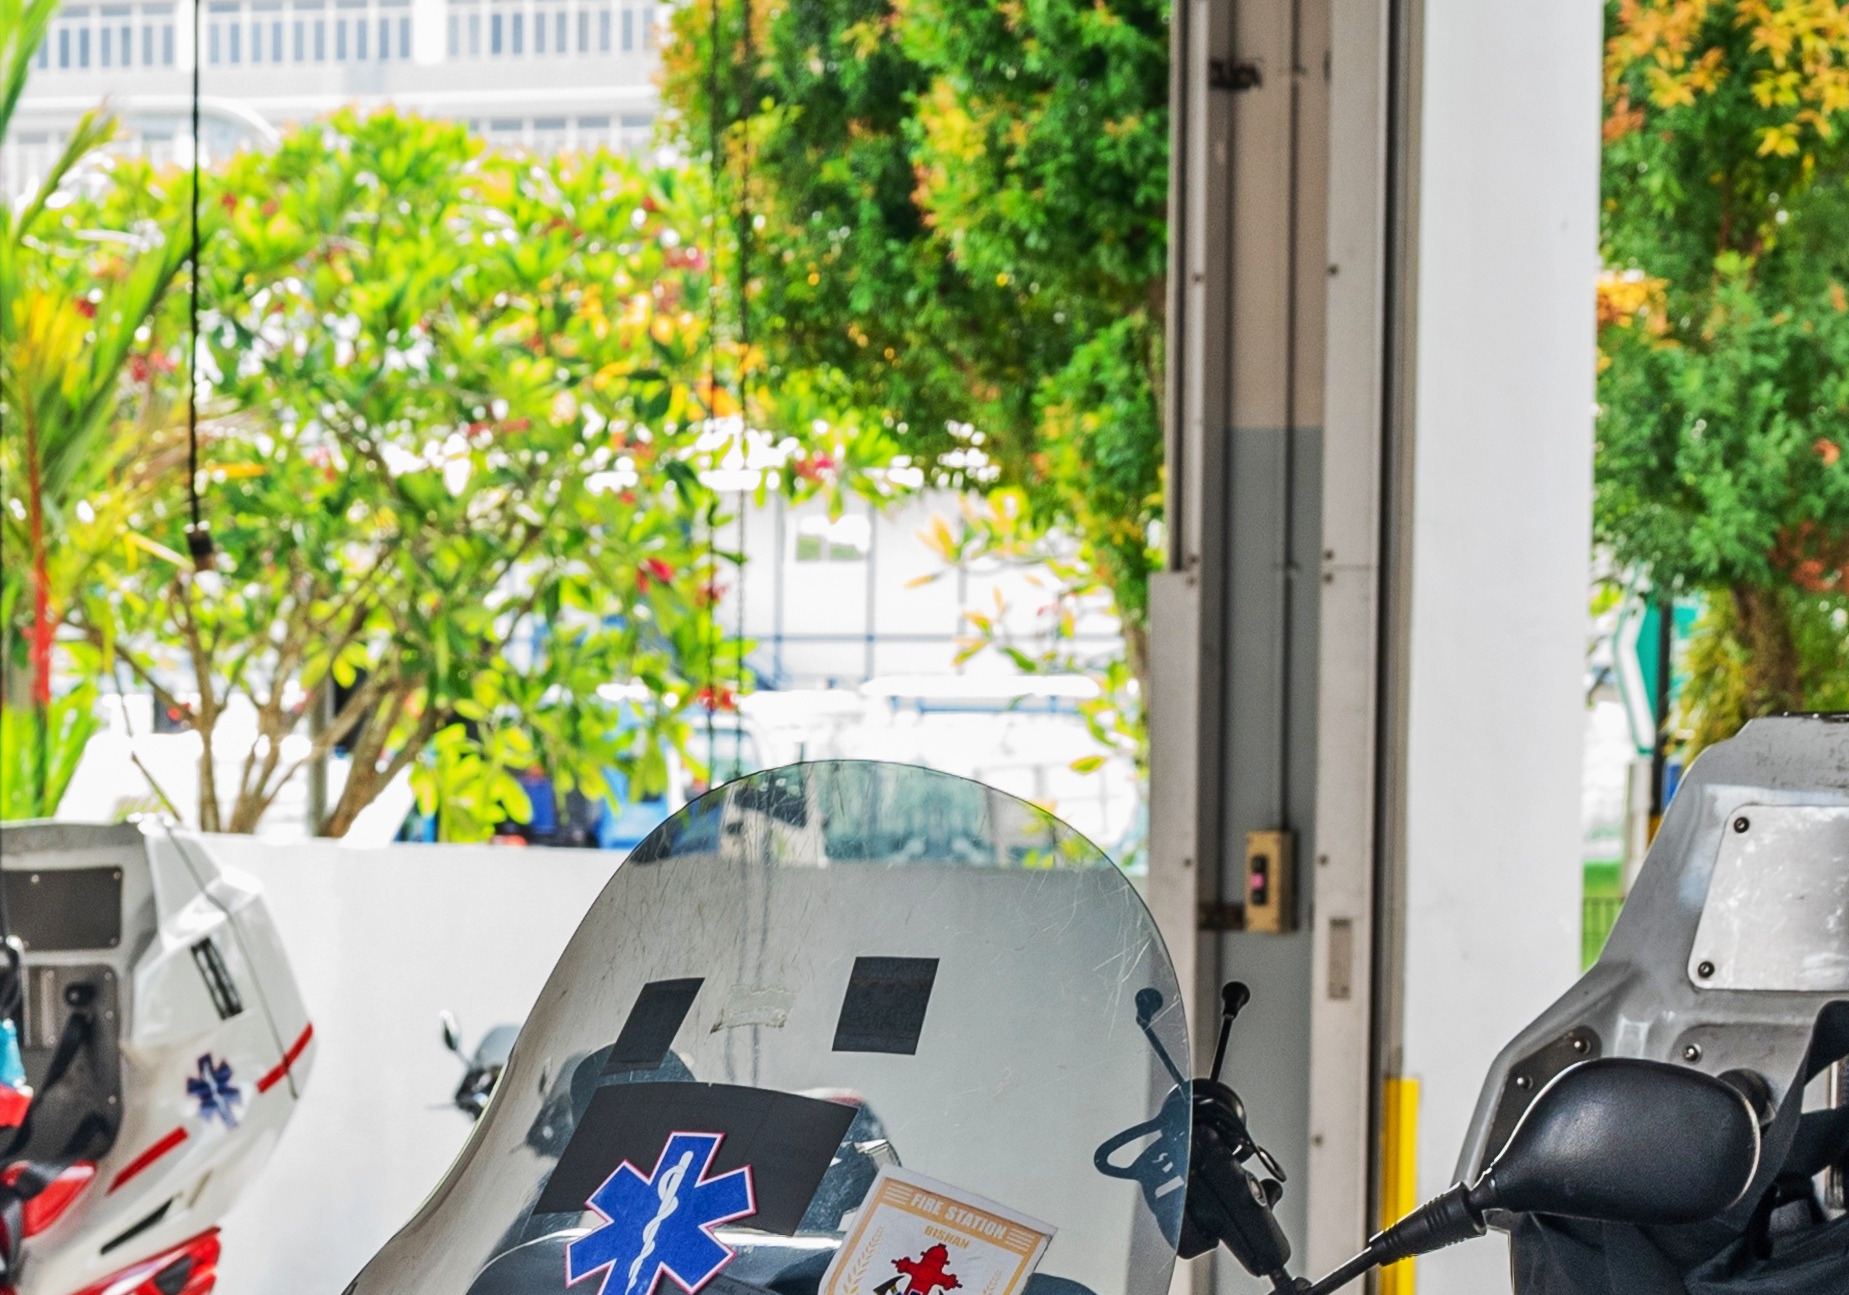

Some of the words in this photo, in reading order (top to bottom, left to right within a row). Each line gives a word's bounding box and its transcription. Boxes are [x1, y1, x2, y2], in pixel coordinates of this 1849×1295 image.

[910, 1193, 945, 1216] FIRE
[944, 1205, 1008, 1239] STATION
[923, 1225, 970, 1249] BISHAN
